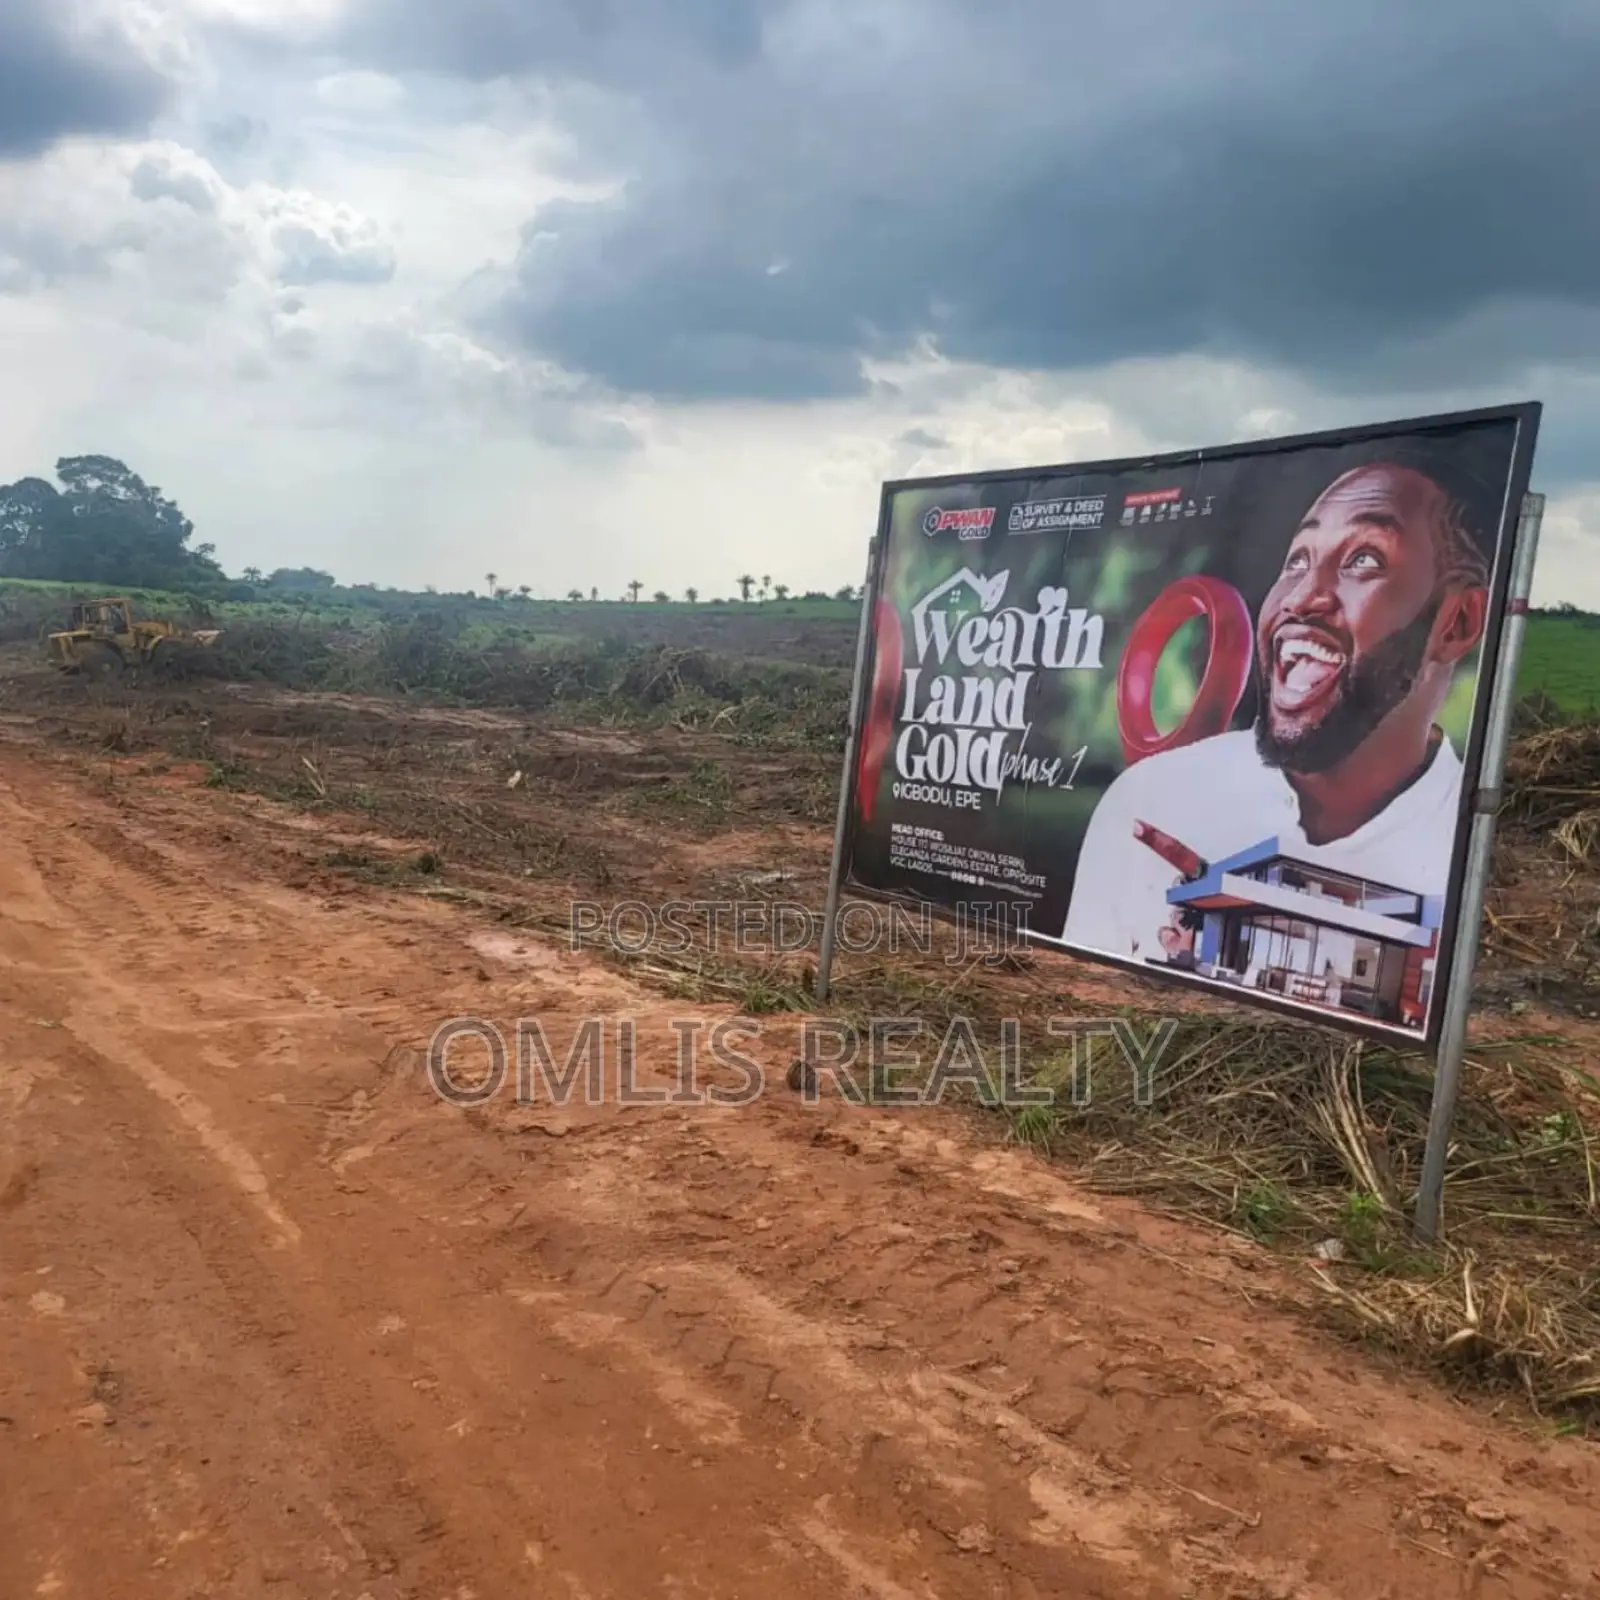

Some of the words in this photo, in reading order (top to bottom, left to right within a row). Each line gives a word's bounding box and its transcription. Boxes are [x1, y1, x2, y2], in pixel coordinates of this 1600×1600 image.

[1023, 503, 1063, 516] SURVEY
[1065, 502, 1074, 514] &
[1076, 500, 1104, 513] DEED
[1022, 517, 1037, 528] OF
[1038, 513, 1104, 527] ASSIGNMENT
[900, 667, 1034, 729] Land
[896, 724, 1008, 790] Gold
[997, 722, 1064, 806] phase
[1060, 745, 1088, 790] 1
[901, 785, 952, 808] IGBODU,
[955, 790, 981, 810] EPE
[1002, 867, 1046, 888] OPPOSITE
